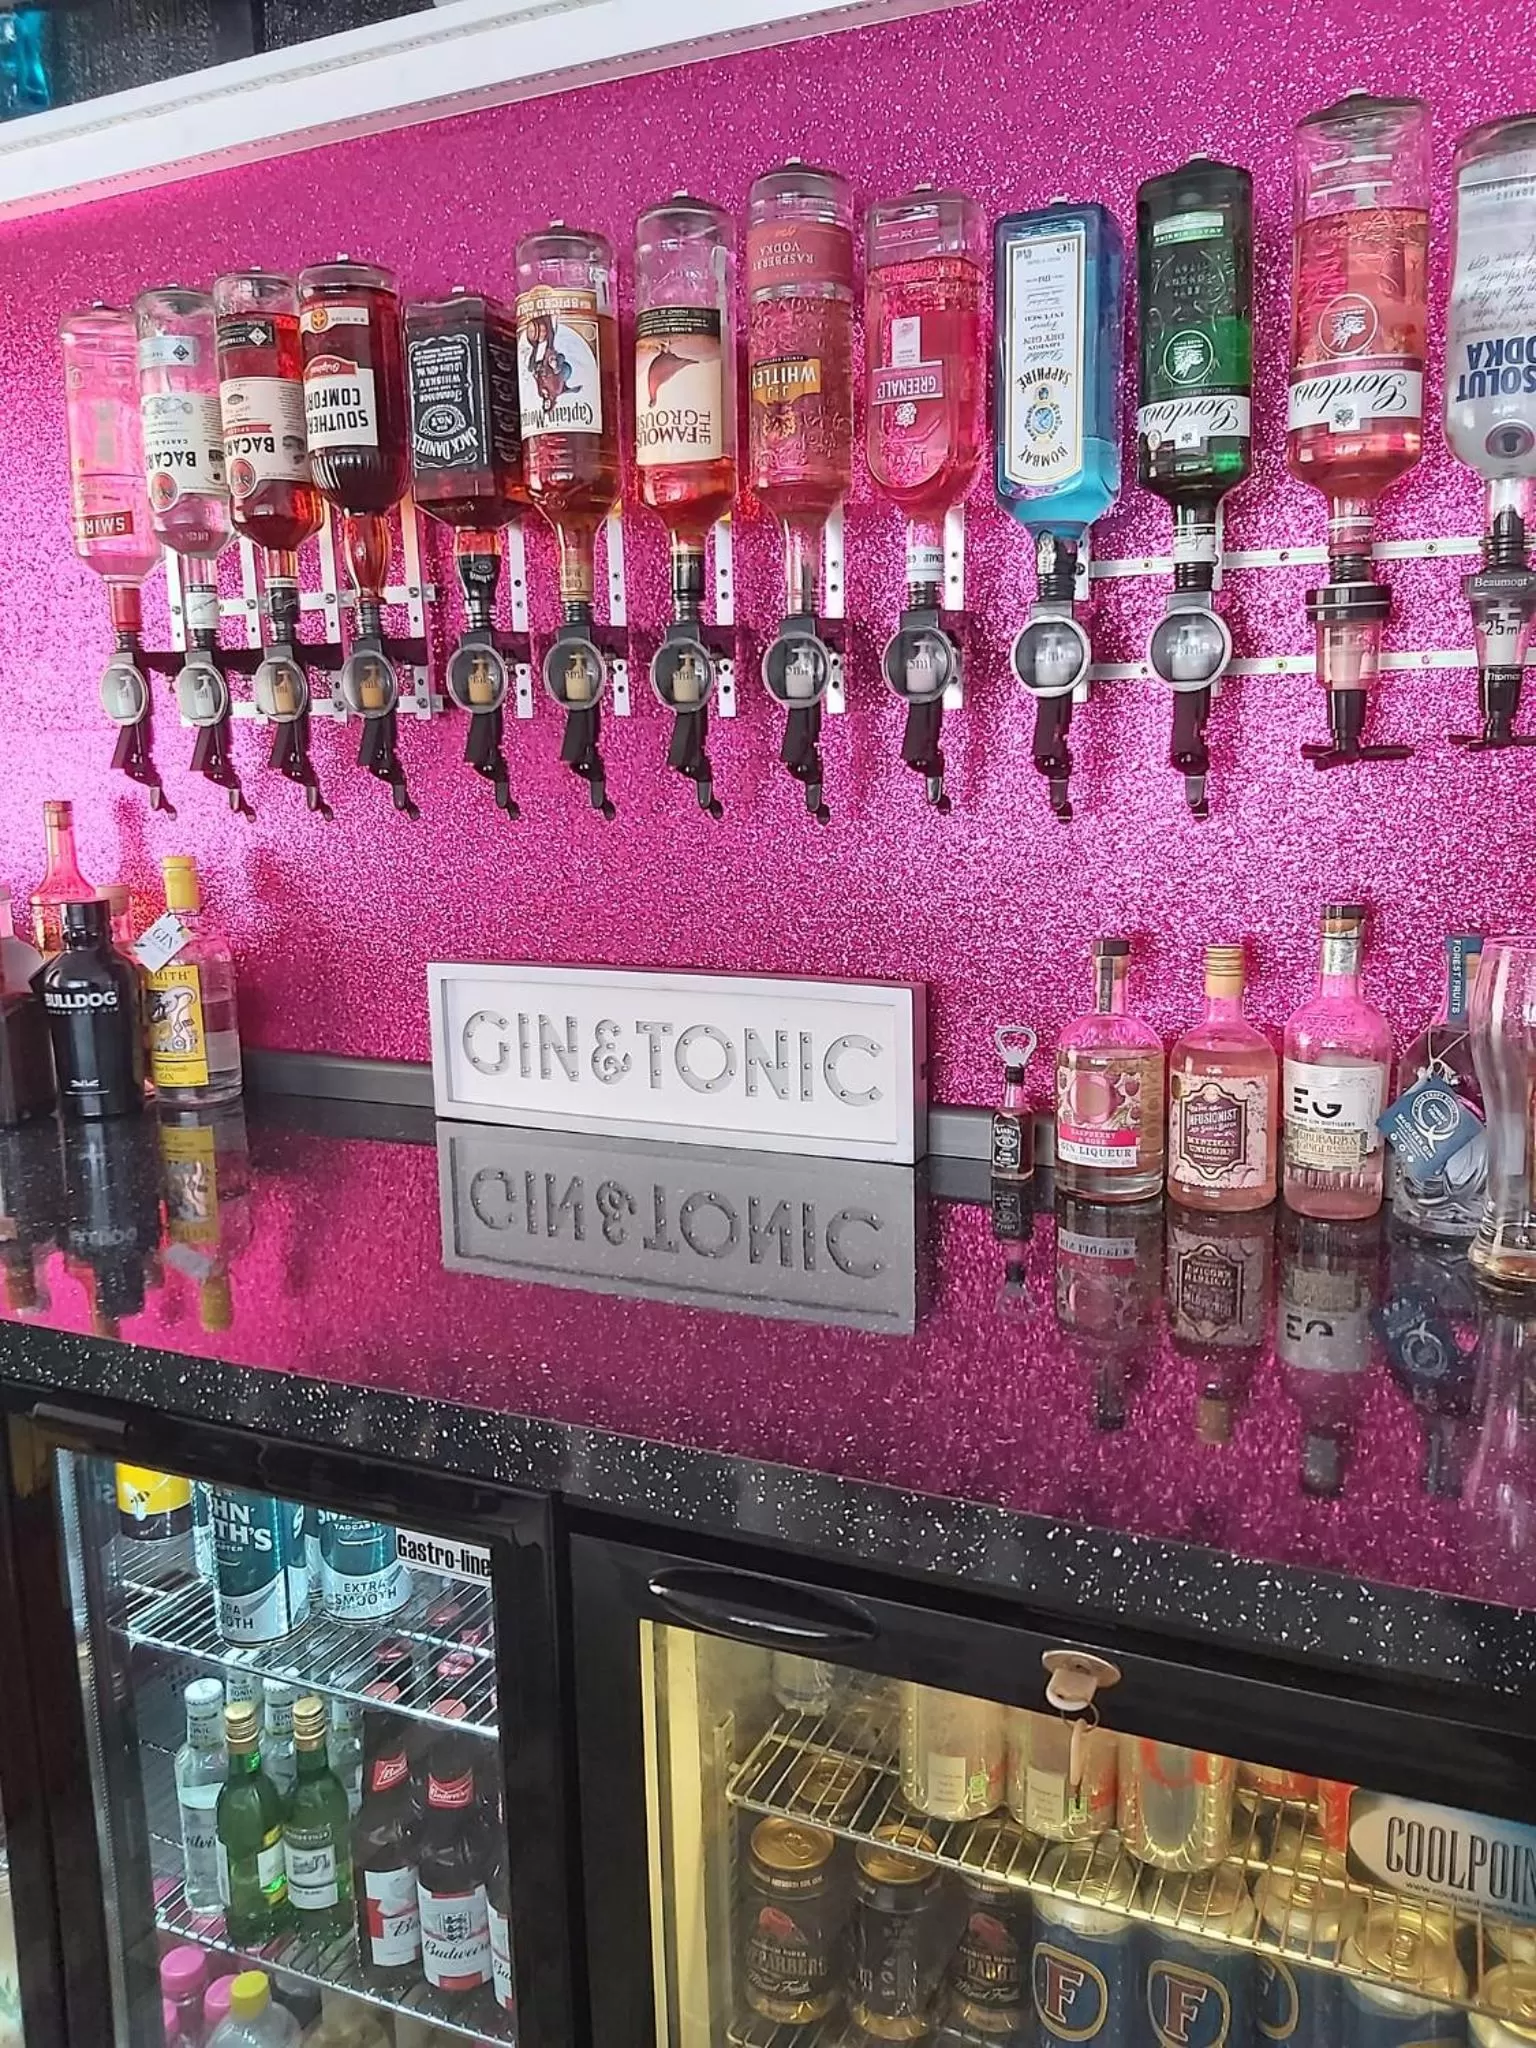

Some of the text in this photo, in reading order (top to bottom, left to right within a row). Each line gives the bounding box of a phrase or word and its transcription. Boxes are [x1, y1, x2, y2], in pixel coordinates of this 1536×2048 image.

[759, 241, 801, 256] VODKA
[751, 366, 816, 390] WHITLEY
[1016, 367, 1072, 390] SAPPHIRE
[450, 426, 479, 453] JACK
[699, 411, 711, 445] THE
[1018, 445, 1068, 467] BOMBAY
[44, 991, 117, 1009] BULLDOG
[1079, 1146, 1132, 1158] LIQUEUR
[397, 1534, 493, 1578] Gastro-line
[1044, 1956, 1084, 2024] F
[1163, 1975, 1208, 2042] F
